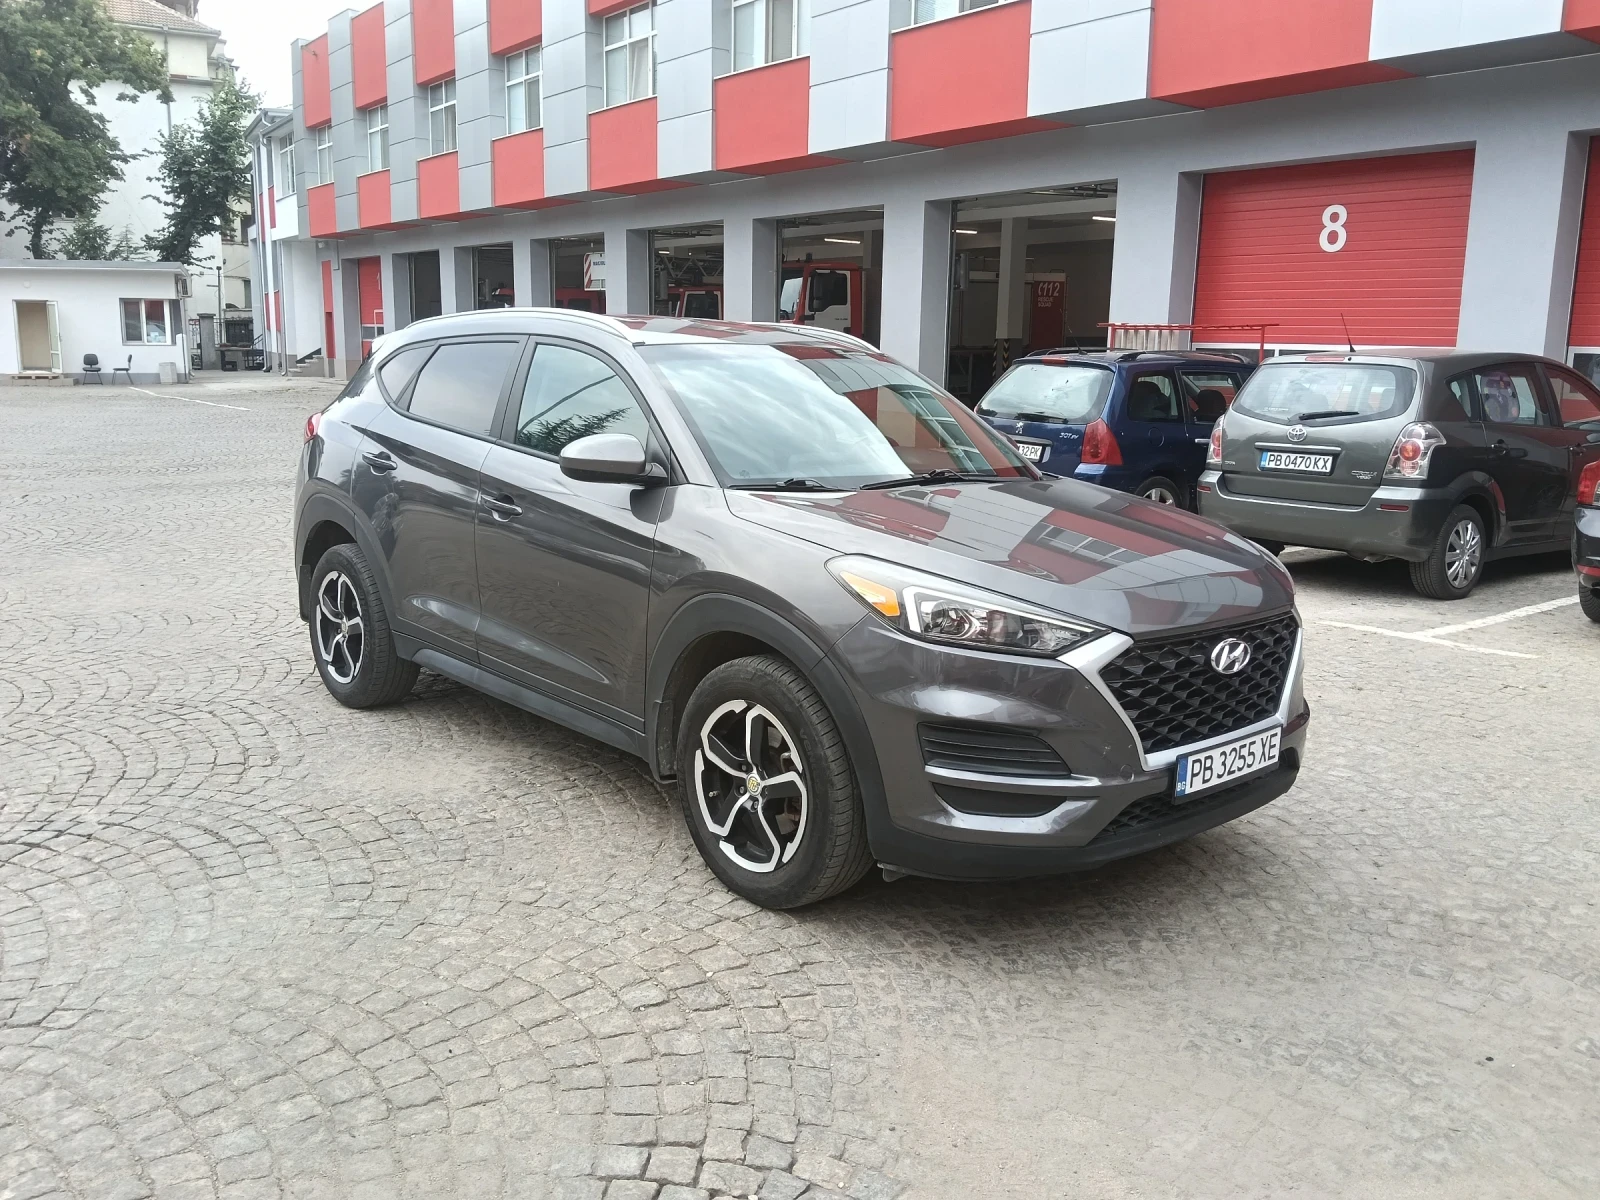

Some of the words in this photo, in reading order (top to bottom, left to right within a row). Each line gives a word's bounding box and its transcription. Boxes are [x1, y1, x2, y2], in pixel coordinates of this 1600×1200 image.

[1319, 204, 1348, 253] 8
[1043, 282, 1060, 296] 112
[1267, 454, 1282, 466] PB
[1284, 455, 1312, 469] 0470
[1313, 457, 1330, 471] KX
[1189, 754, 1214, 788] PB
[1216, 740, 1257, 779] 3255
[1258, 732, 1278, 764] XE
